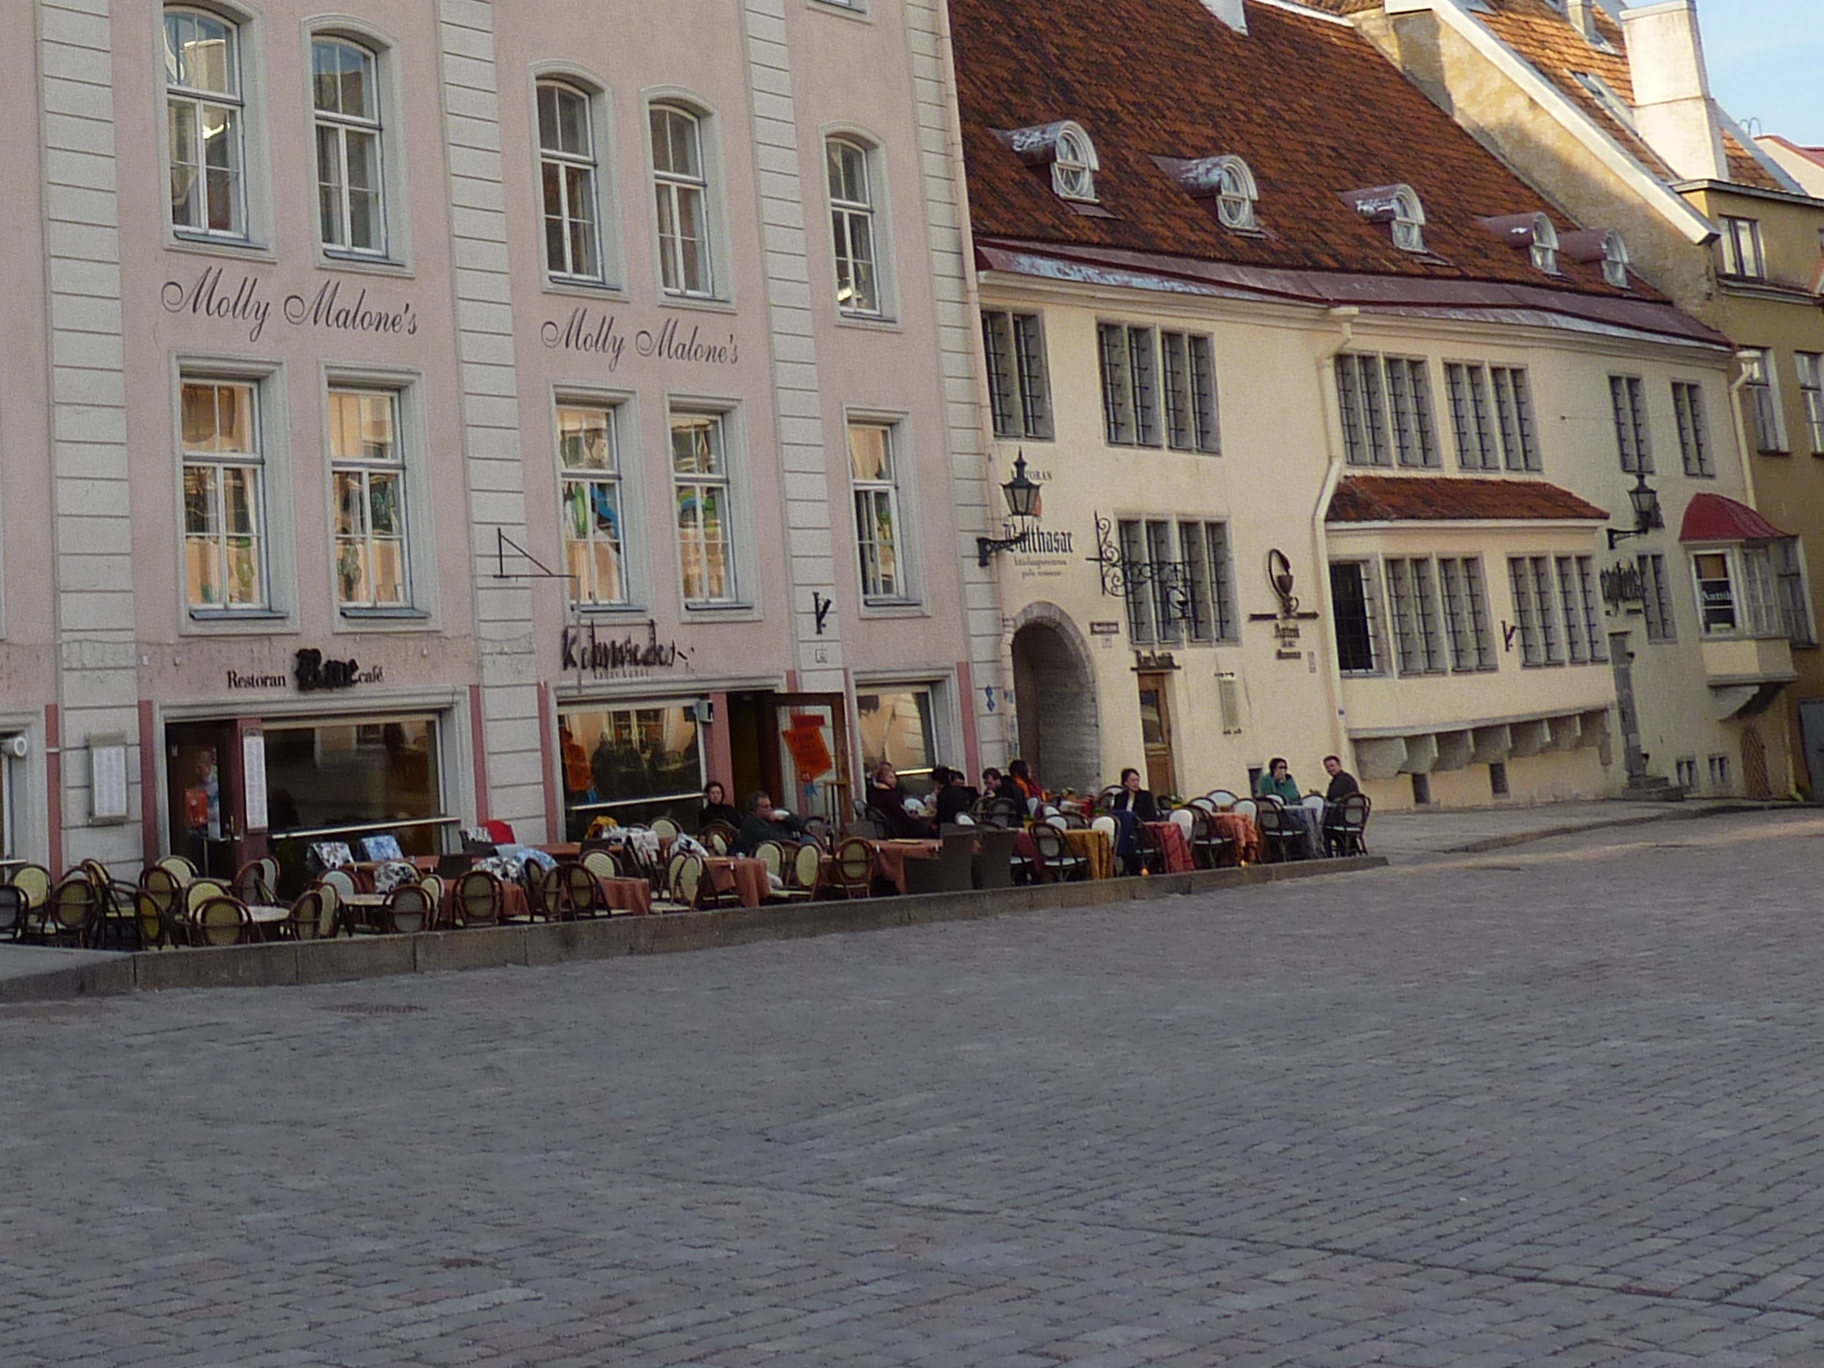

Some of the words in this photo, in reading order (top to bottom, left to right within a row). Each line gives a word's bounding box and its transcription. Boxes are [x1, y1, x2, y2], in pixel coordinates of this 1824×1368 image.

[161, 266, 270, 342] Molly
[284, 279, 417, 334] Malone's
[541, 307, 625, 372] Molly
[635, 317, 738, 364] Malone's
[227, 670, 286, 689] Restoran
